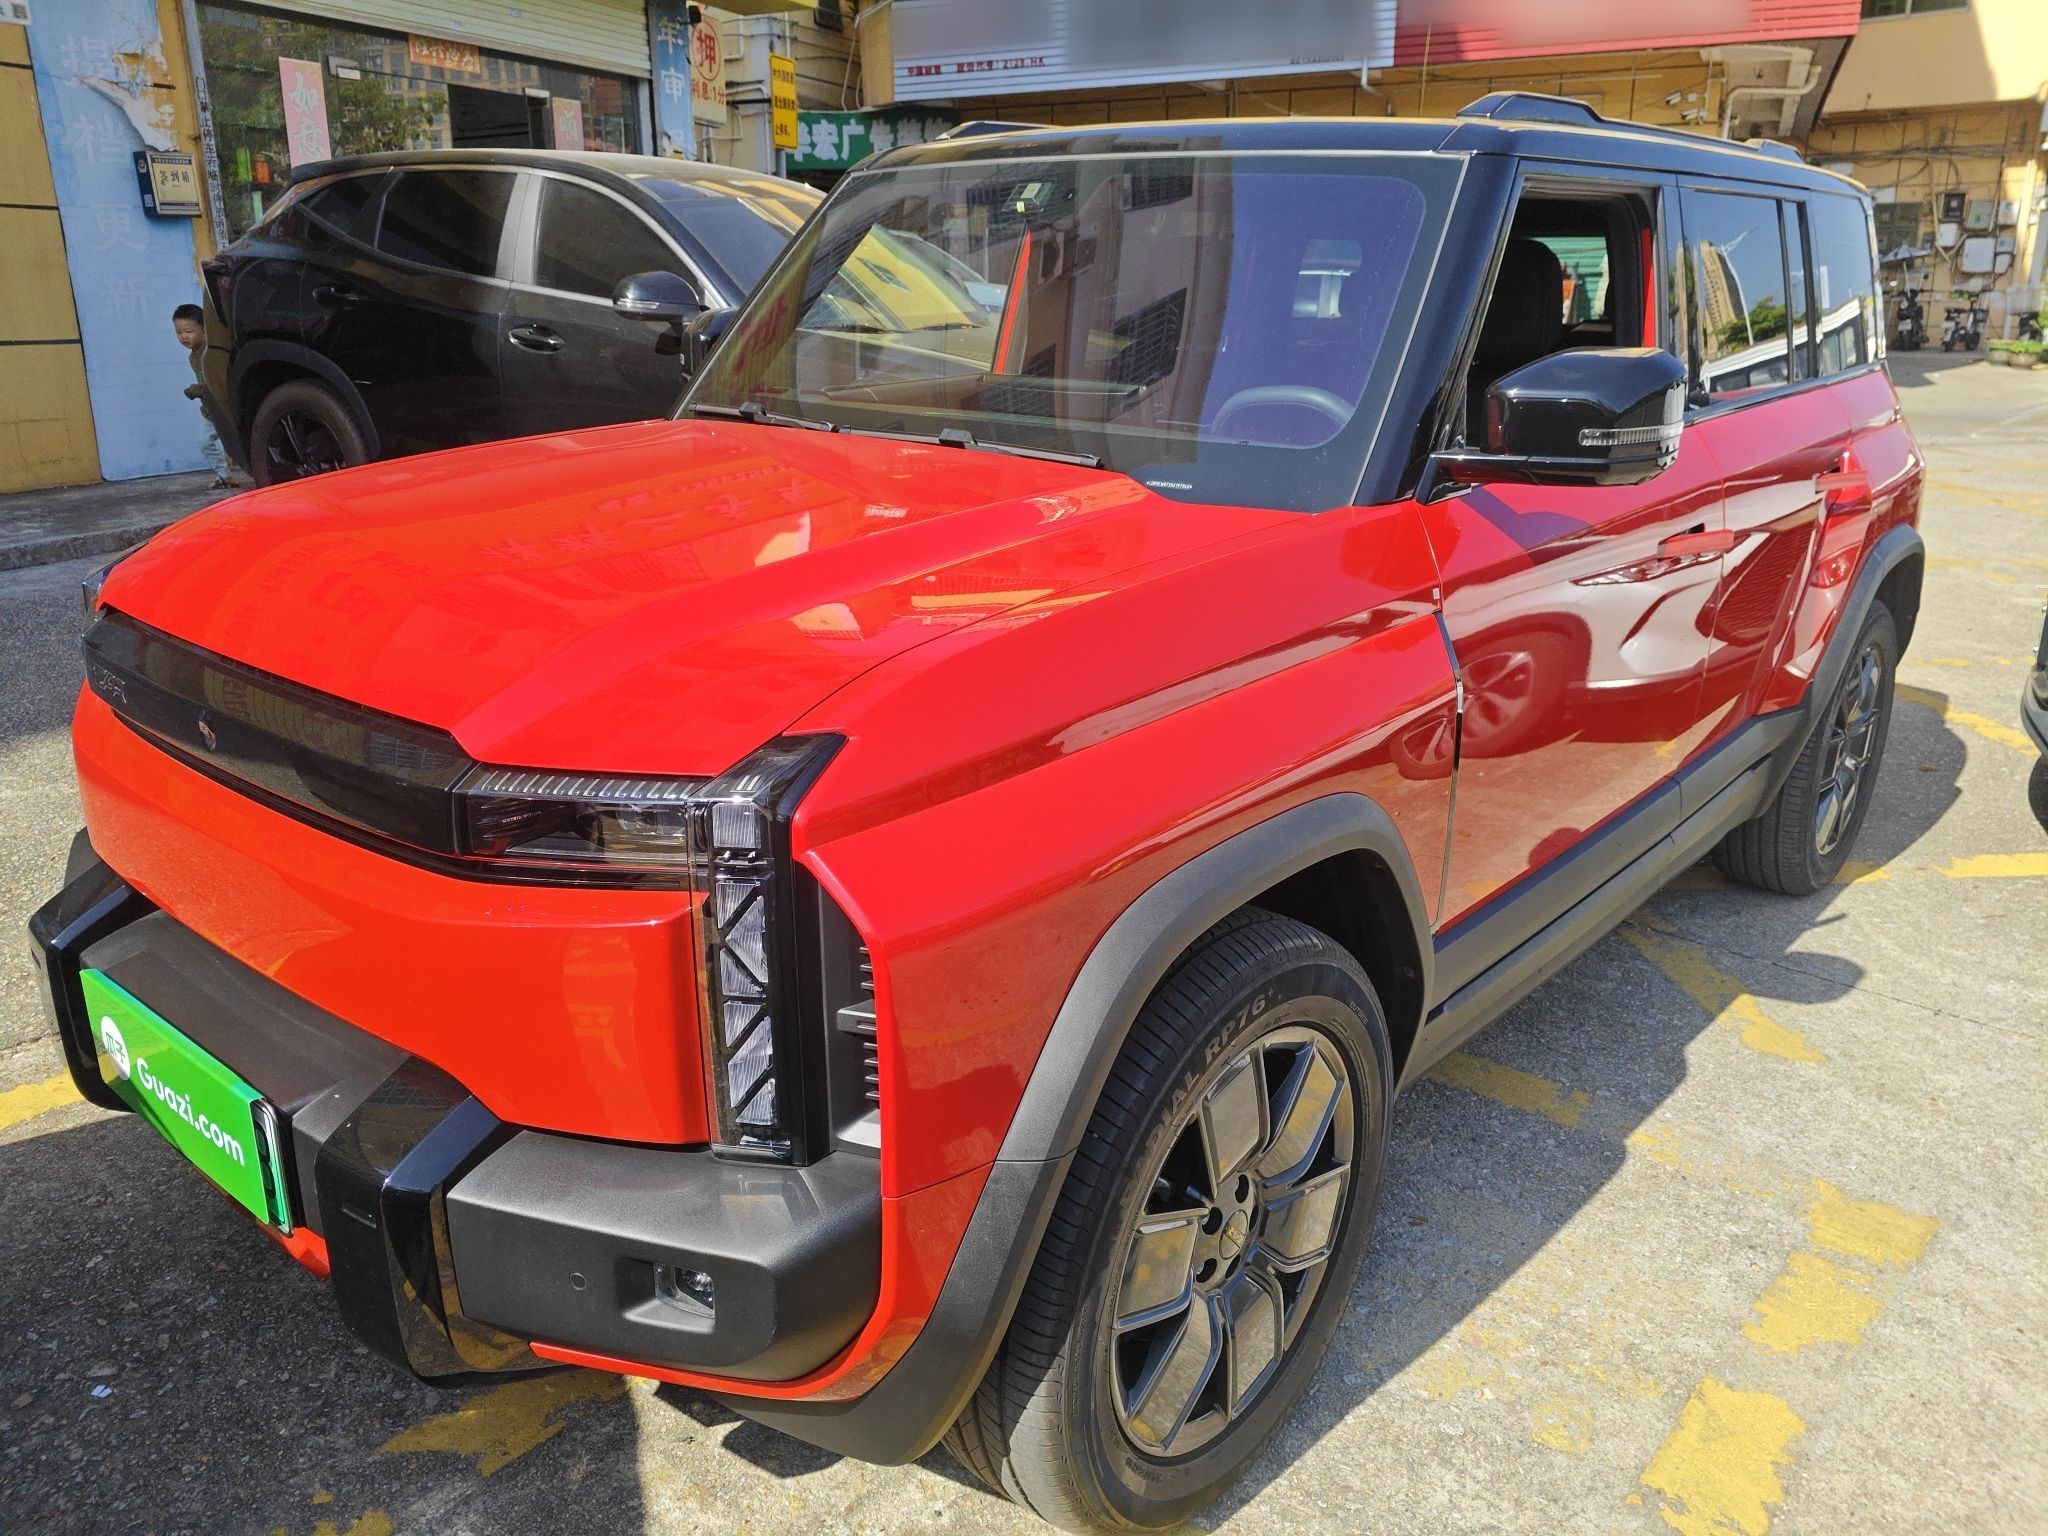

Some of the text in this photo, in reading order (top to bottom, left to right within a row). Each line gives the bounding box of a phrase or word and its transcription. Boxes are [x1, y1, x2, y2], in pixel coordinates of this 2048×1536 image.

[696, 30, 716, 73] 押
[288, 71, 325, 161] 如意
[1349, 1001, 1369, 1026] OUTSIDE
[136, 1057, 245, 1167] Guazi.com
